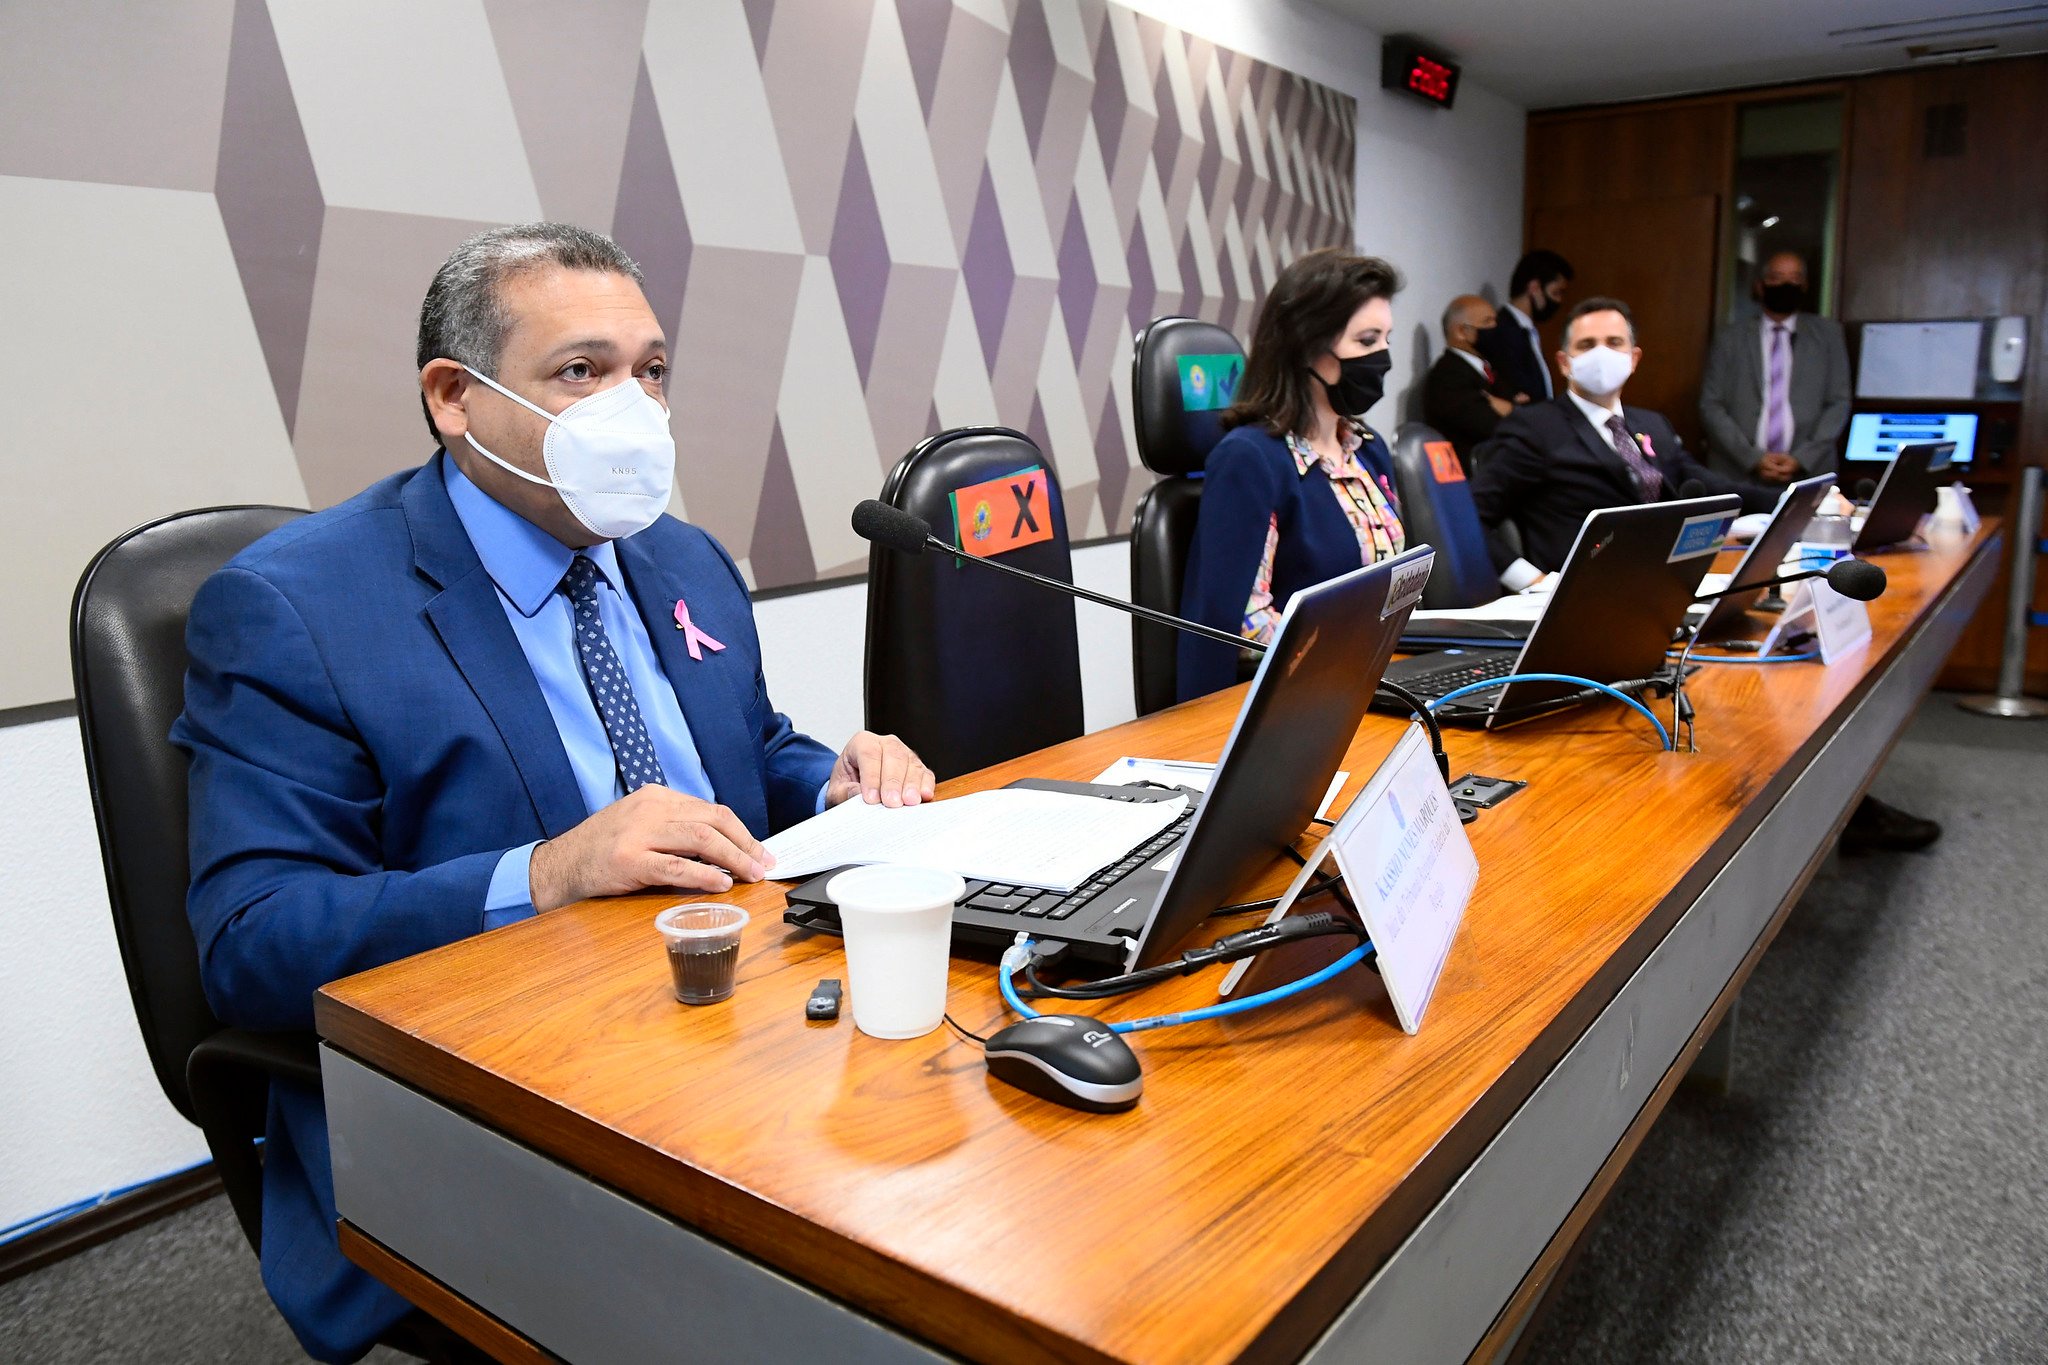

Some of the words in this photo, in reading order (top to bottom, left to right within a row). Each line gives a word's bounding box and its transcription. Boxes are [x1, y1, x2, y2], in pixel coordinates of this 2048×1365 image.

[611, 467, 637, 475] KN95
[1375, 850, 1403, 903] KASSIO
[1396, 825, 1419, 866] NUNES
[1413, 790, 1440, 842] MARQUES
